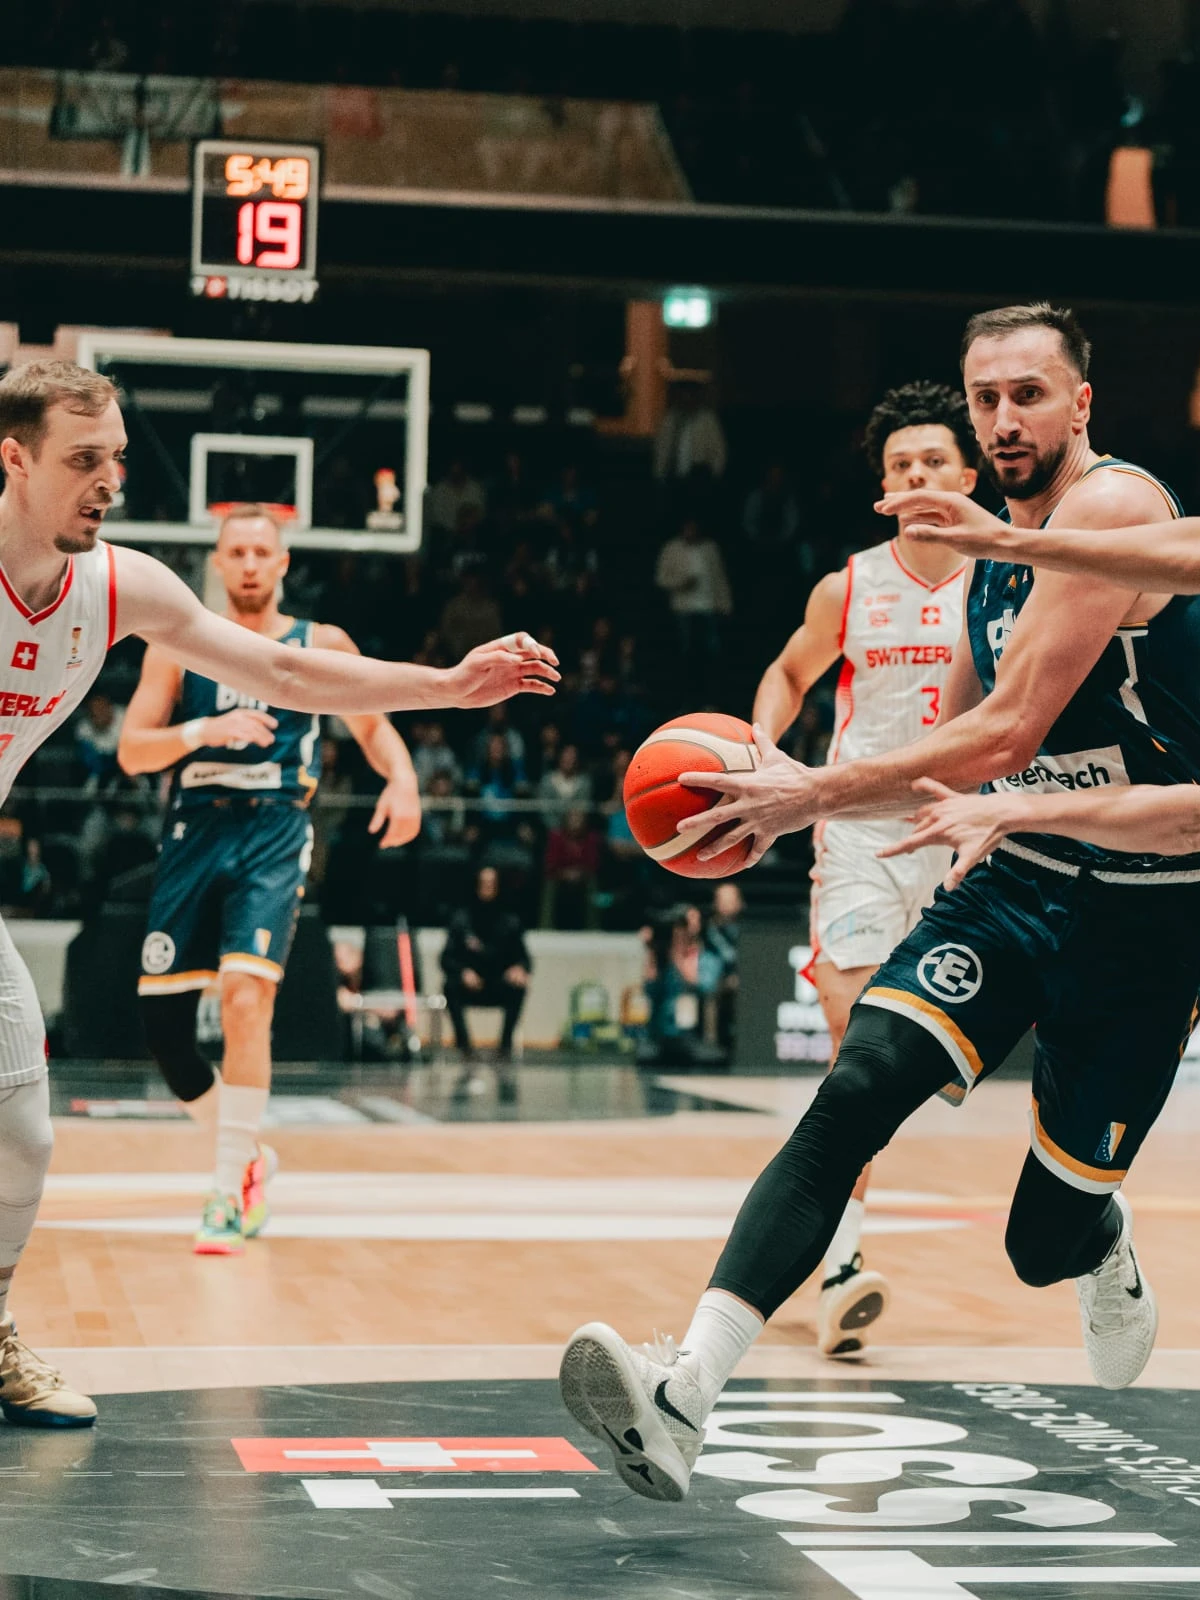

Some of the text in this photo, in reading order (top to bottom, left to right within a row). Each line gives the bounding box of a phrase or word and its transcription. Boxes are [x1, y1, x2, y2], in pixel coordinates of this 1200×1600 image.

[225, 154, 310, 200] 5:49
[237, 201, 302, 270] 19
[921, 687, 940, 725] 3
[952, 1383, 1067, 1410] 1853
[1011, 1412, 1160, 1452] SINCE
